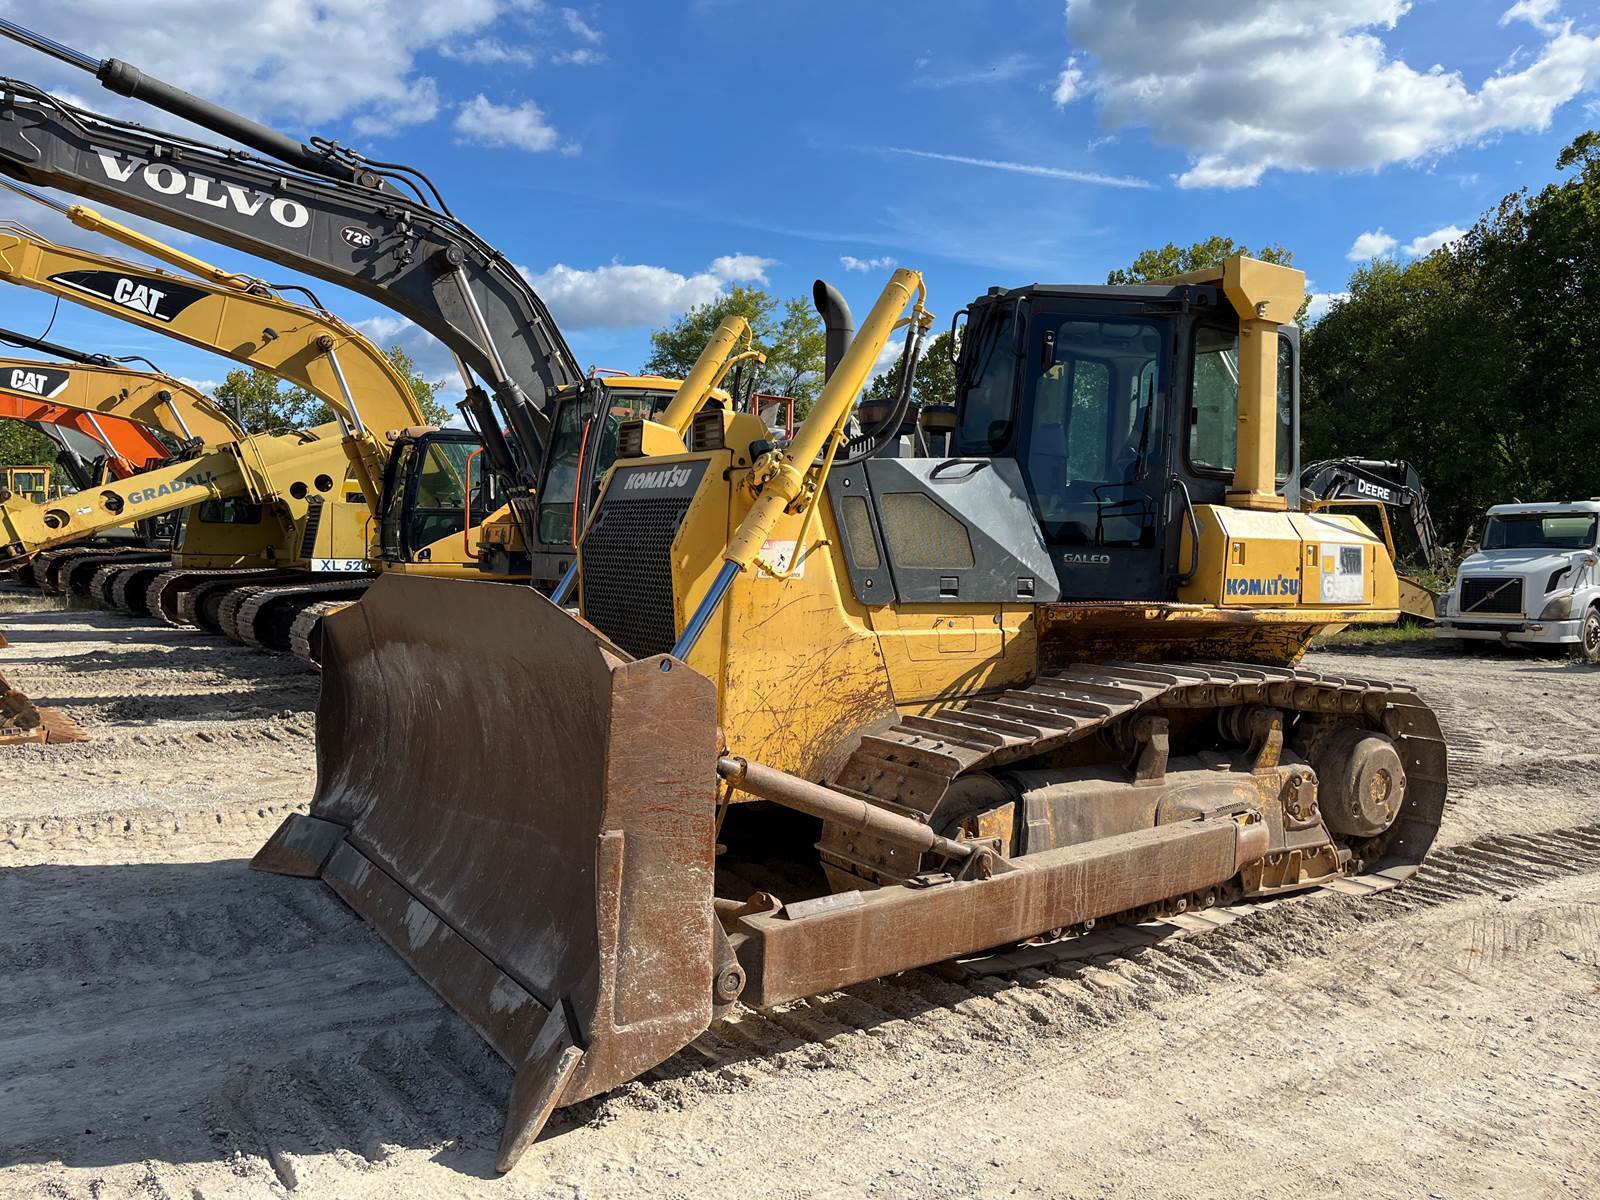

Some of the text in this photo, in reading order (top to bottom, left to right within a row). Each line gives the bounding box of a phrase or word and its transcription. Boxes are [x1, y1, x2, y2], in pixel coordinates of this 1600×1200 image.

[90, 145, 309, 228] VOLVO
[345, 229, 370, 246] 726
[114, 278, 165, 315] CAT
[10, 369, 48, 394] CAT
[128, 471, 216, 504] GRADALL
[624, 465, 692, 490] KOMATSU
[1358, 478, 1390, 500] DEERE
[321, 560, 341, 571] XL
[1063, 553, 1110, 564] GALEO
[1226, 574, 1299, 595] KOMATSU
